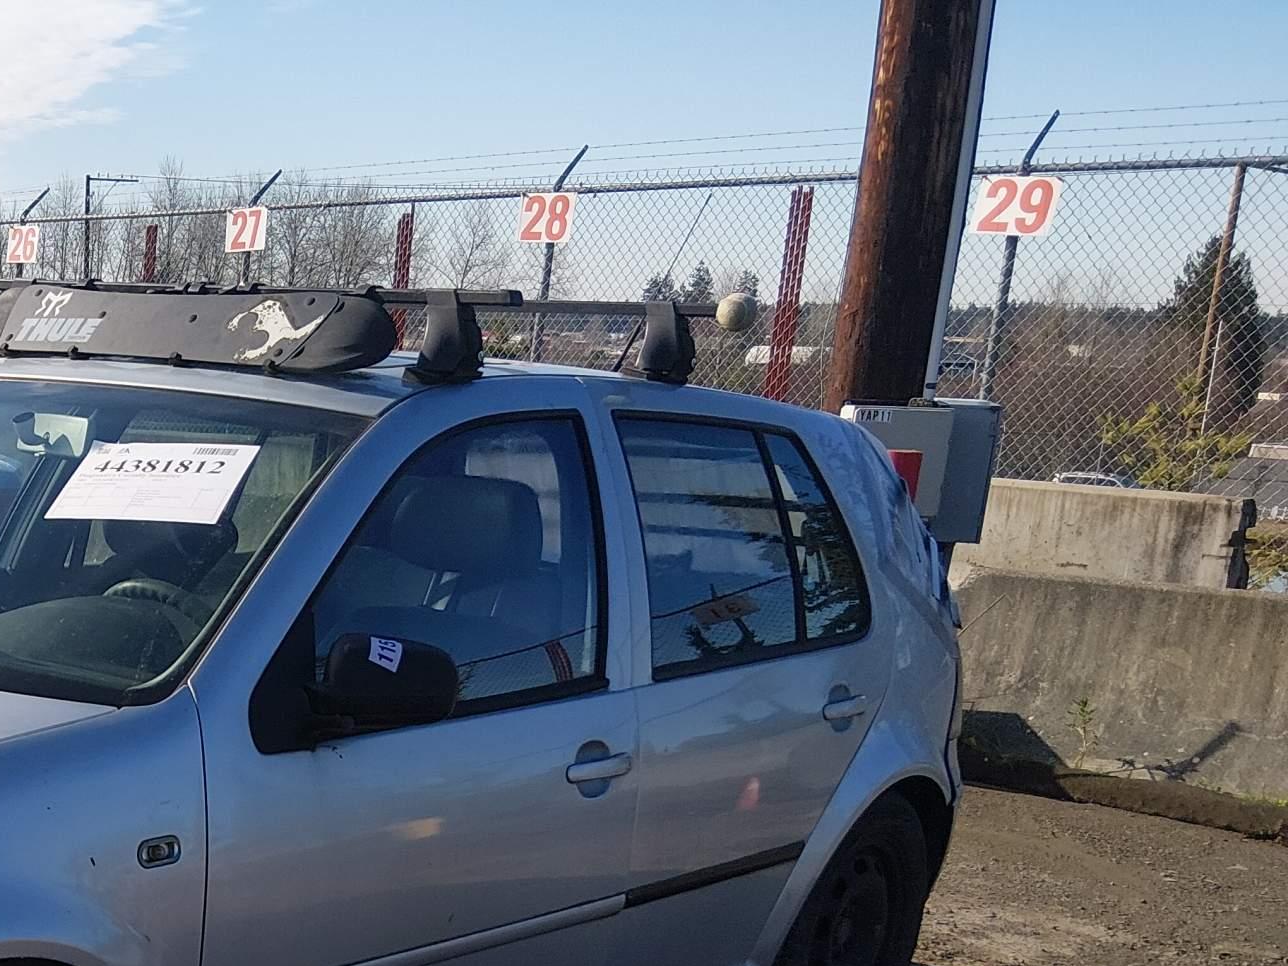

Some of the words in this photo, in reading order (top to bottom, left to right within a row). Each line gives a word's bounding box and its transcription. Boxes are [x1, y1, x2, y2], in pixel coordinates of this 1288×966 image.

[520, 195, 569, 241] 28
[977, 178, 1053, 234] 29
[8, 228, 35, 261] 26
[231, 210, 261, 249] 27
[15, 318, 101, 342] THULE
[94, 459, 225, 474] 44381812
